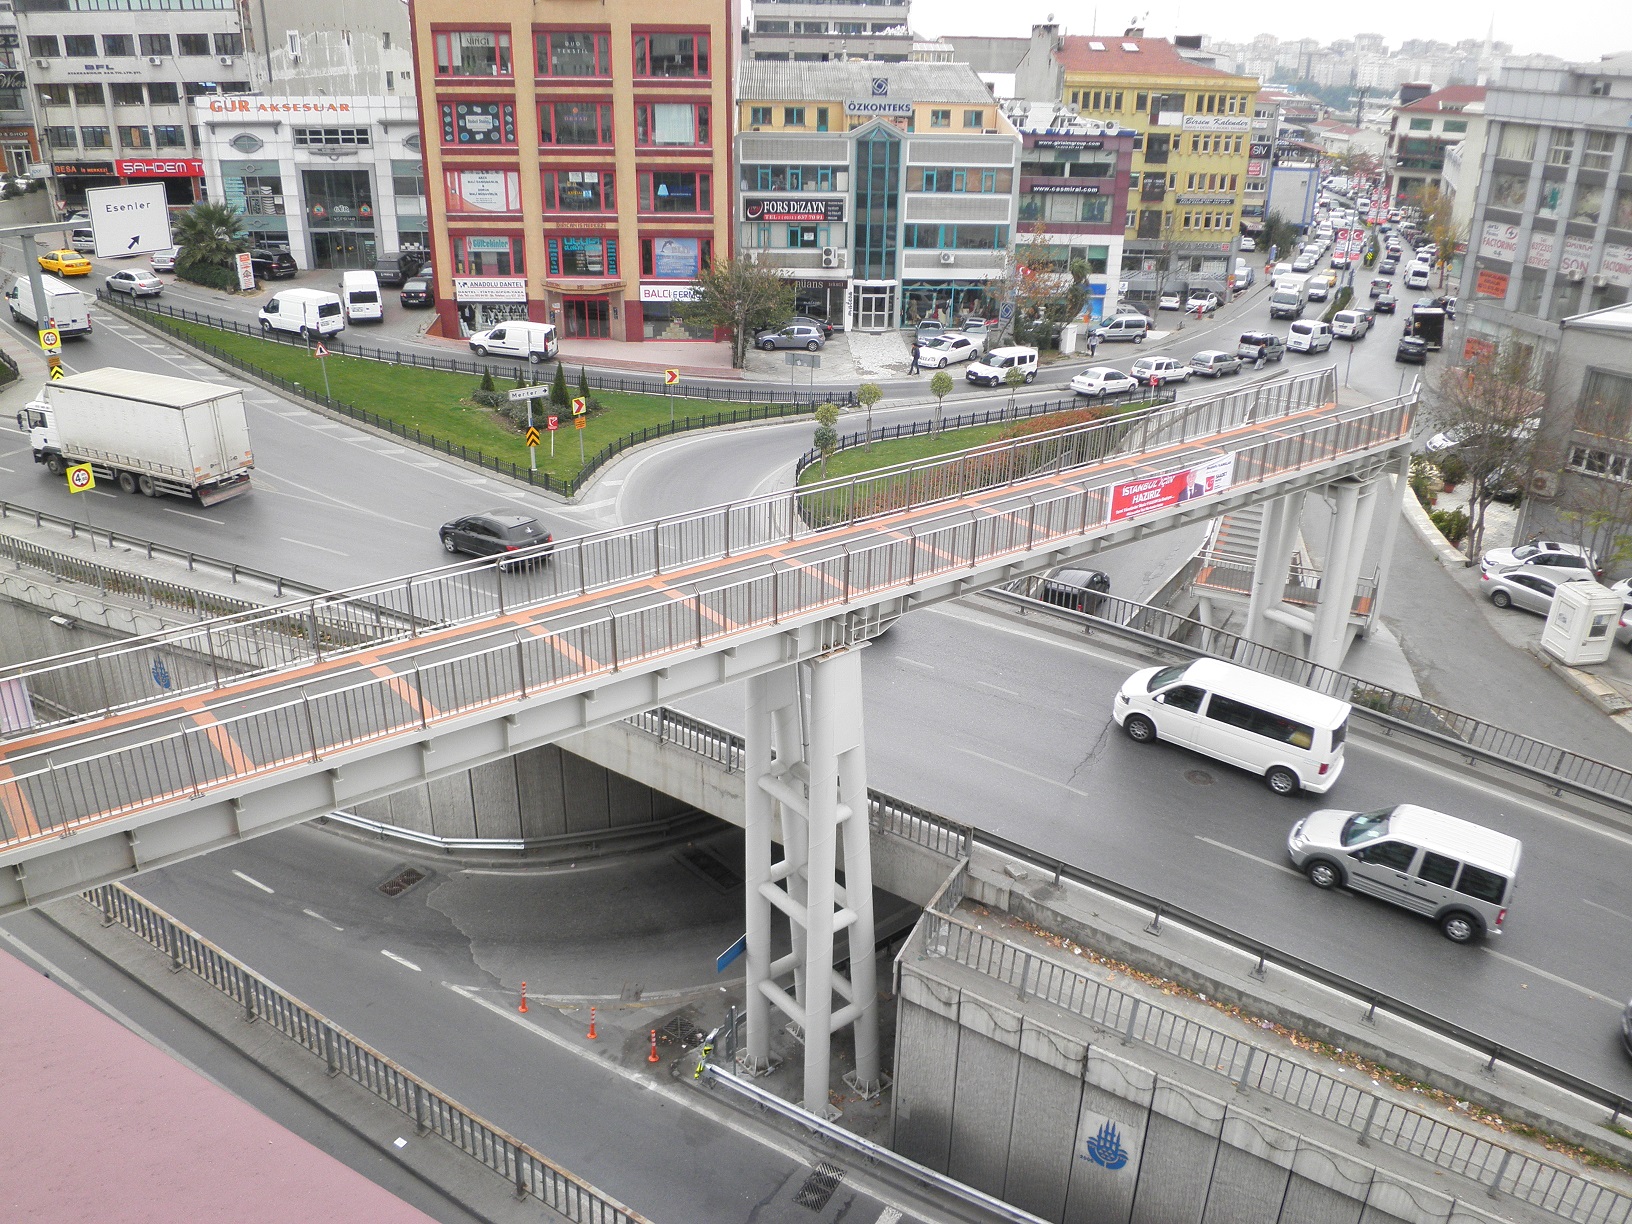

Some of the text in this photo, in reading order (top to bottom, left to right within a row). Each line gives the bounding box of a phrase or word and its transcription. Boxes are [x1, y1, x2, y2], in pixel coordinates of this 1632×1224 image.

[209, 98, 351, 113] GÜR AKSESUAR
[848, 101, 911, 113] ÖZKONTEKS
[123, 162, 188, 174] ŞAHDEM
[105, 202, 151, 213] Esenler
[764, 201, 789, 213] FORS
[1482, 236, 1517, 252] FACTORING
[795, 280, 824, 289] nüans
[643, 289, 671, 298] BALCI
[511, 389, 538, 399] Merter
[1121, 479, 1158, 496] İSTANBUL
